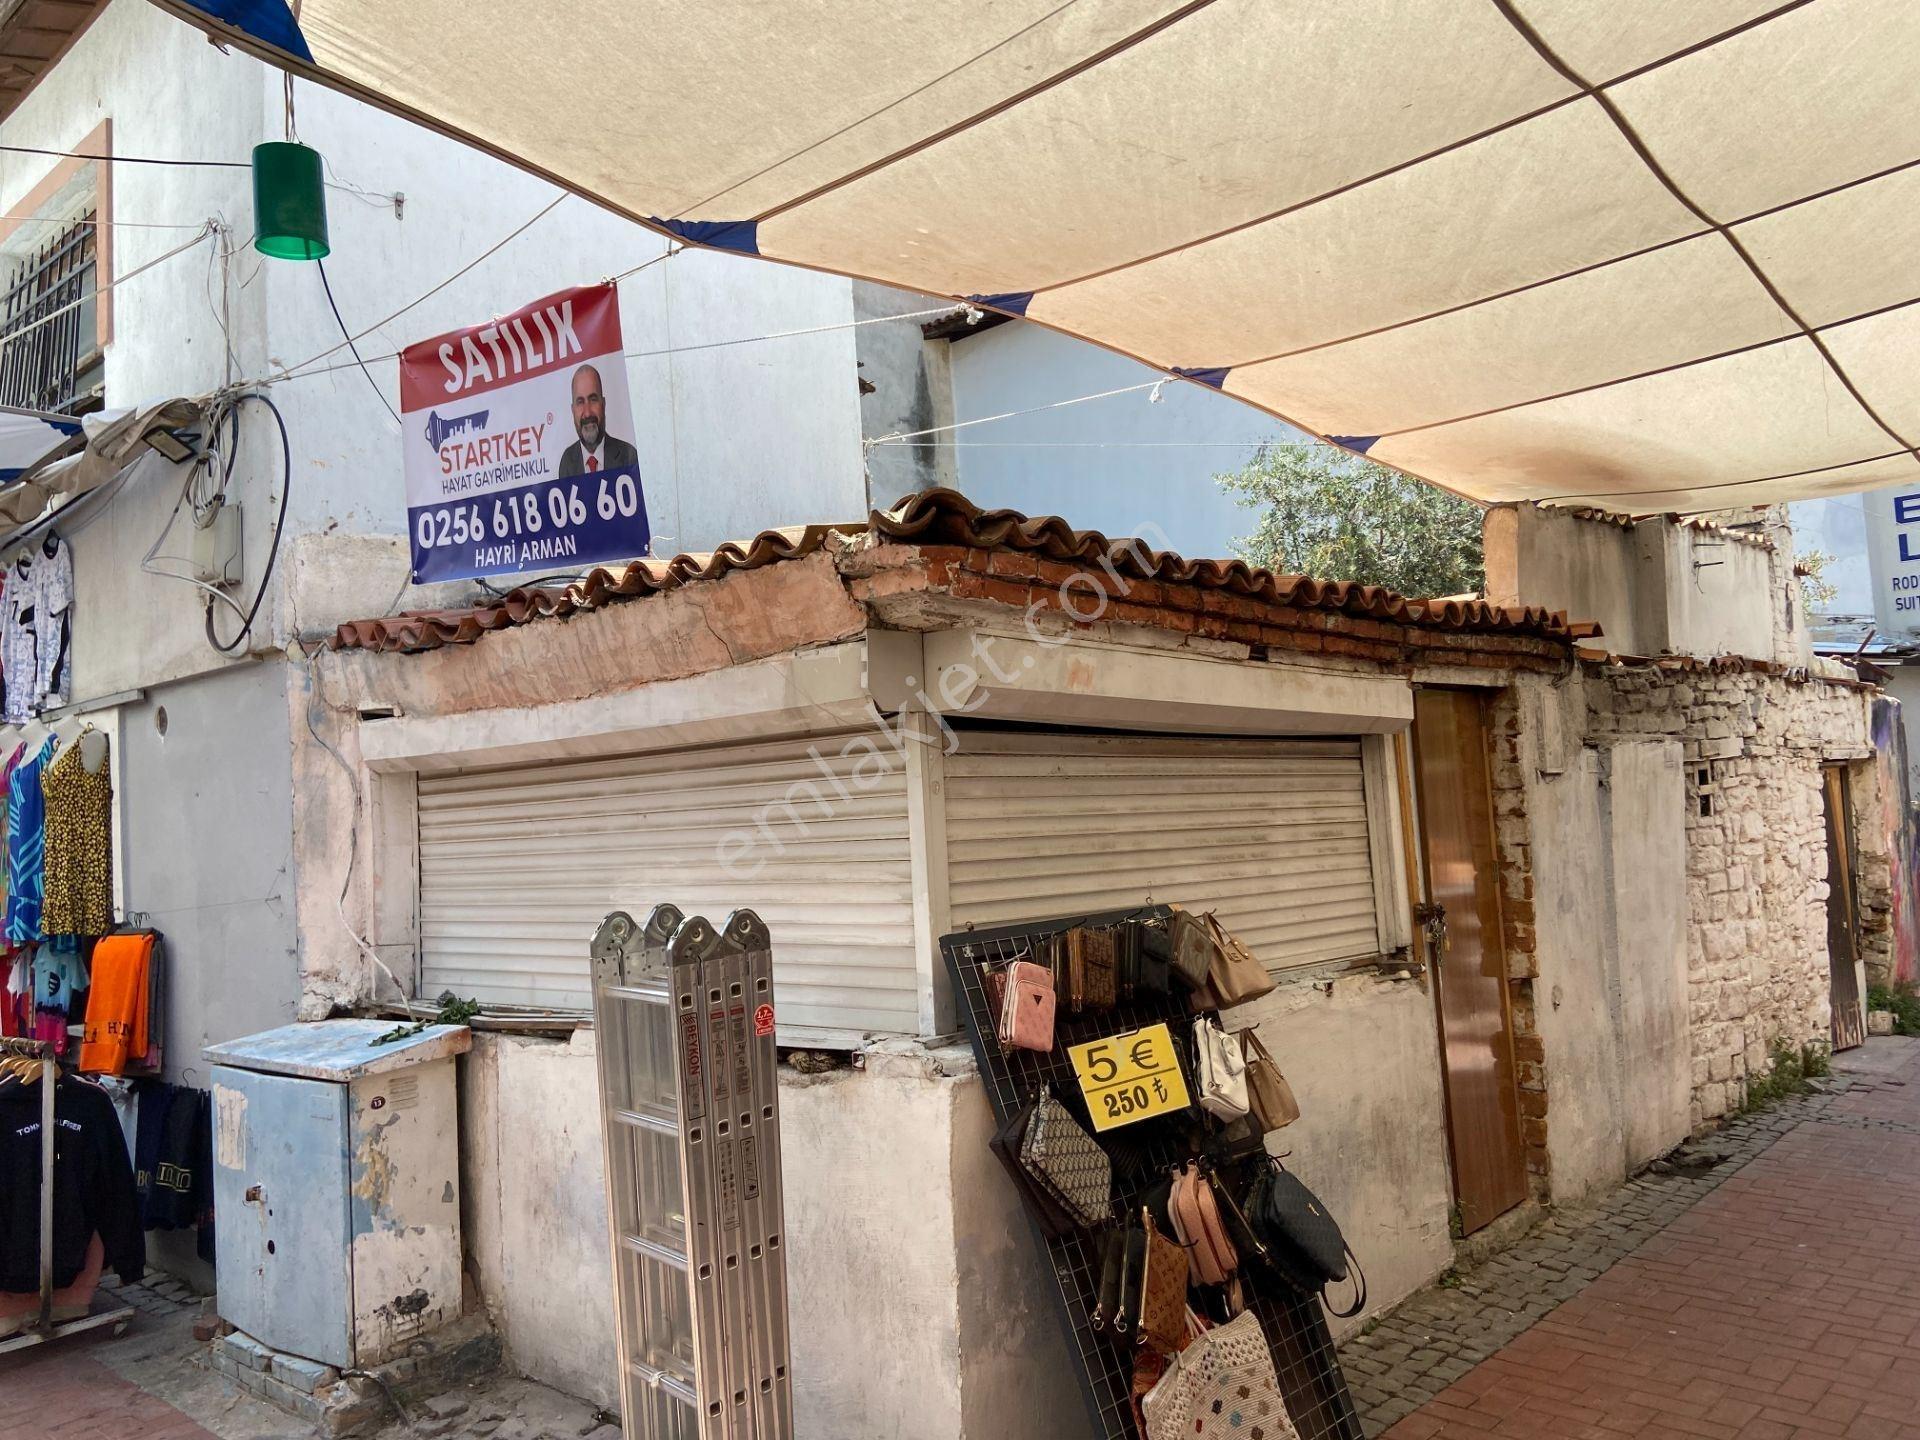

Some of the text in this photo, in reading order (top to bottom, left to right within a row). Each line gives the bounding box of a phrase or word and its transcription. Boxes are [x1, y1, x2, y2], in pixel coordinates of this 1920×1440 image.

[438, 300, 583, 394] SATILIK
[440, 424, 545, 474] STARTKEY
[442, 457, 550, 495] HAYAT GAYRİMENKUL
[418, 474, 638, 549] 0256 618 06 60
[474, 534, 577, 568] HAYRİ ARMAN
[1892, 575, 1920, 591] ROD
[687, 1024, 701, 1076] BEYKON
[1087, 1038, 1160, 1082] 5 €
[1103, 1085, 1149, 1118] 250
